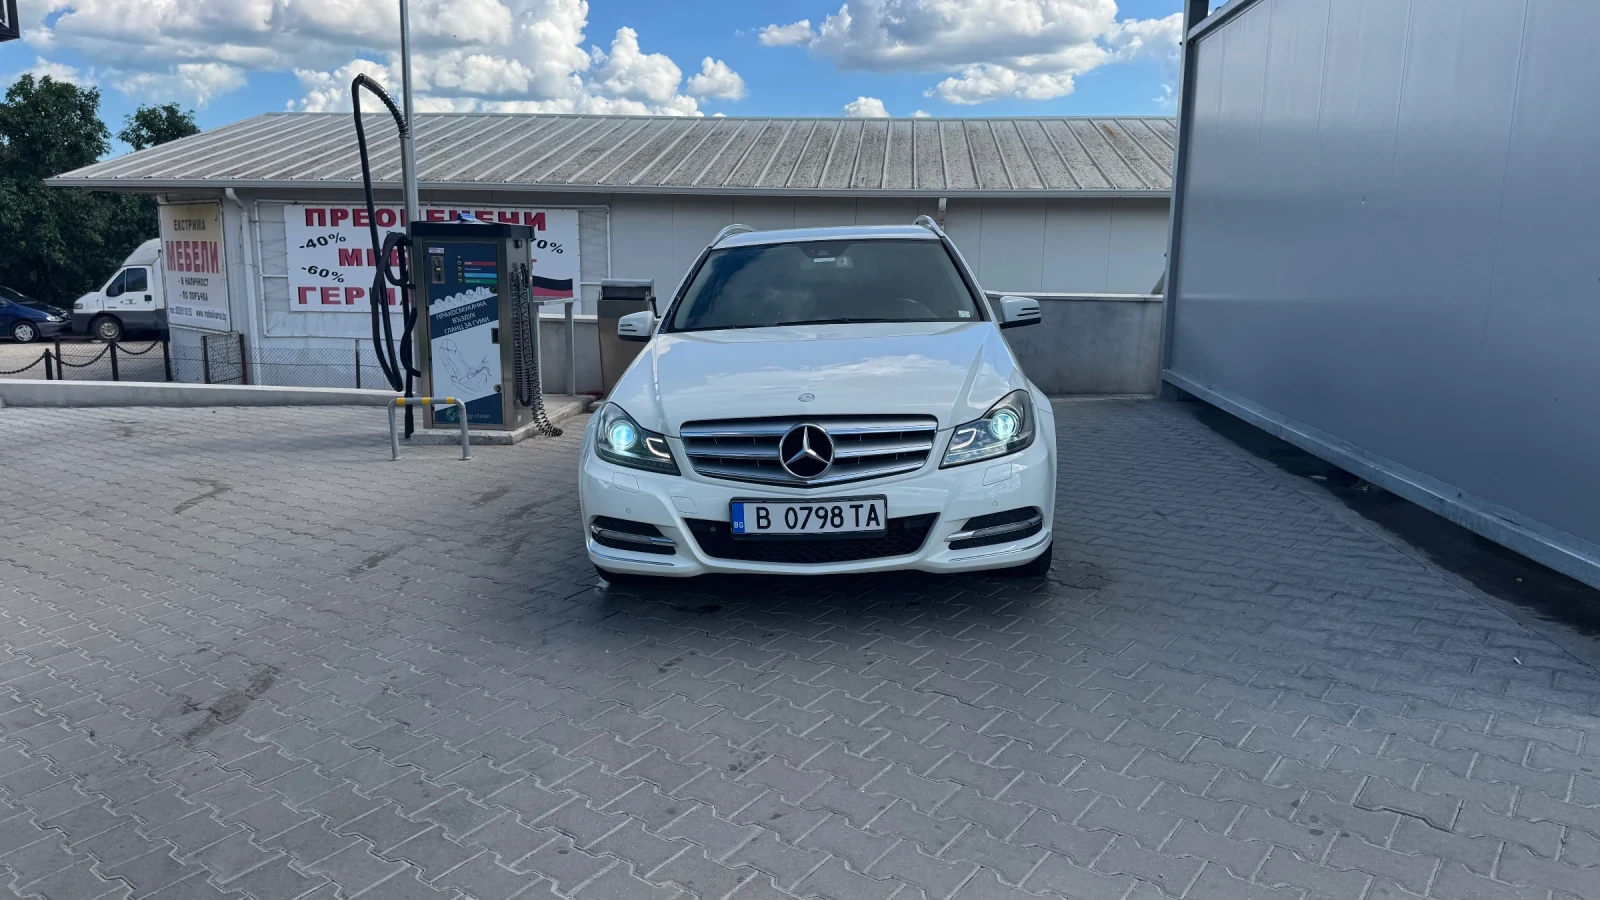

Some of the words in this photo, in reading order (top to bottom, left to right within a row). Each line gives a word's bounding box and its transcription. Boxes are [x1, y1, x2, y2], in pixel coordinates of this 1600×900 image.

[174, 219, 206, 231] ЕКСТРИМА
[299, 232, 346, 249] -40%
[530, 238, 563, 254] 0%
[165, 241, 219, 274] МЕБЕЛИ
[185, 277, 209, 287] НАЛИЧНОСТ
[301, 265, 344, 283] -60%
[189, 291, 208, 301] ПОРЪЧКА
[436, 301, 487, 320] ПРАХОСМУКАЧКА
[451, 312, 476, 324] ВЪЗДУХ
[444, 324, 464, 335] ГЛАНЦ
[464, 321, 472, 329] ЗА
[472, 316, 490, 326] ГУМИ
[756, 506, 771, 530] B
[784, 505, 844, 530] 0798
[849, 503, 880, 527] TA
[733, 521, 744, 529] BG
